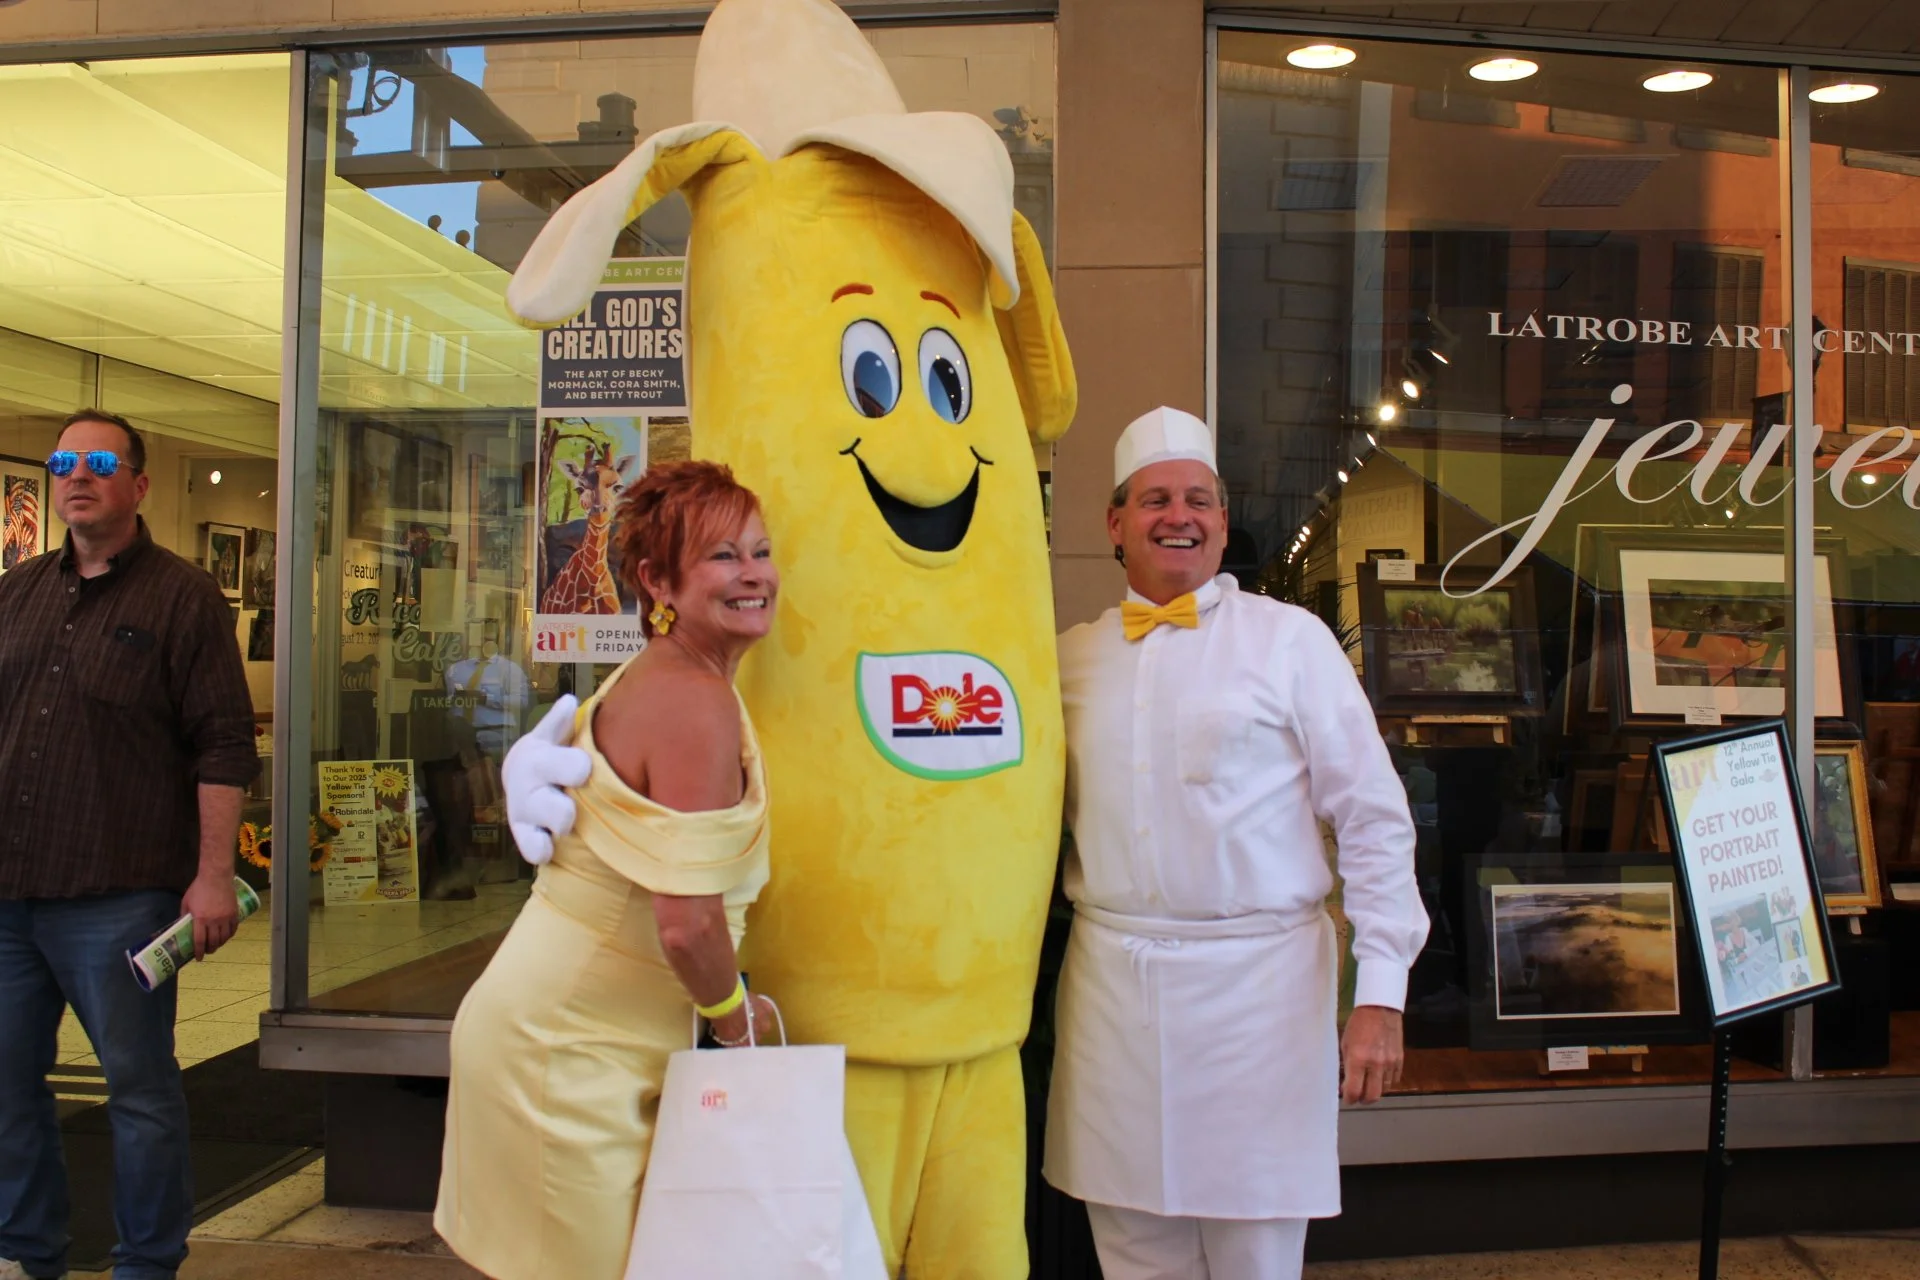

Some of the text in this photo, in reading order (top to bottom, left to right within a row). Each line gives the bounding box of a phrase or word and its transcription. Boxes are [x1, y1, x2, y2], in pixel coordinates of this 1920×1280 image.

[602, 268, 620, 277] BE
[626, 267, 651, 277] ART
[558, 297, 678, 329] LL GOD'S
[1487, 312, 1692, 346] LATROBE
[1705, 324, 1790, 350] ART
[548, 329, 683, 360] CREATURES
[565, 369, 664, 379] THE ART OF BECKY
[548, 379, 680, 389] MORMACK, CORA SMITH,
[565, 390, 663, 400] AND BETTY TROUT
[1439, 383, 1920, 599] jewe
[346, 587, 421, 627] Rco
[536, 626, 588, 652] art
[596, 643, 644, 652] FRIDAY
[422, 696, 479, 708] TAKE OUT
[891, 672, 1003, 731] Dole
[1741, 735, 1774, 753] Annual
[1727, 752, 1776, 772] Yellow Tie
[326, 783, 352, 791] Yellow
[333, 774, 347, 782] Our
[1730, 771, 1755, 787] Gala
[326, 790, 365, 801] Sponsors!
[335, 807, 374, 816] Robindale
[1692, 800, 1779, 838] GET YOUR
[1699, 827, 1779, 866] PORTRAIT
[1708, 853, 1784, 893] PAINTED!
